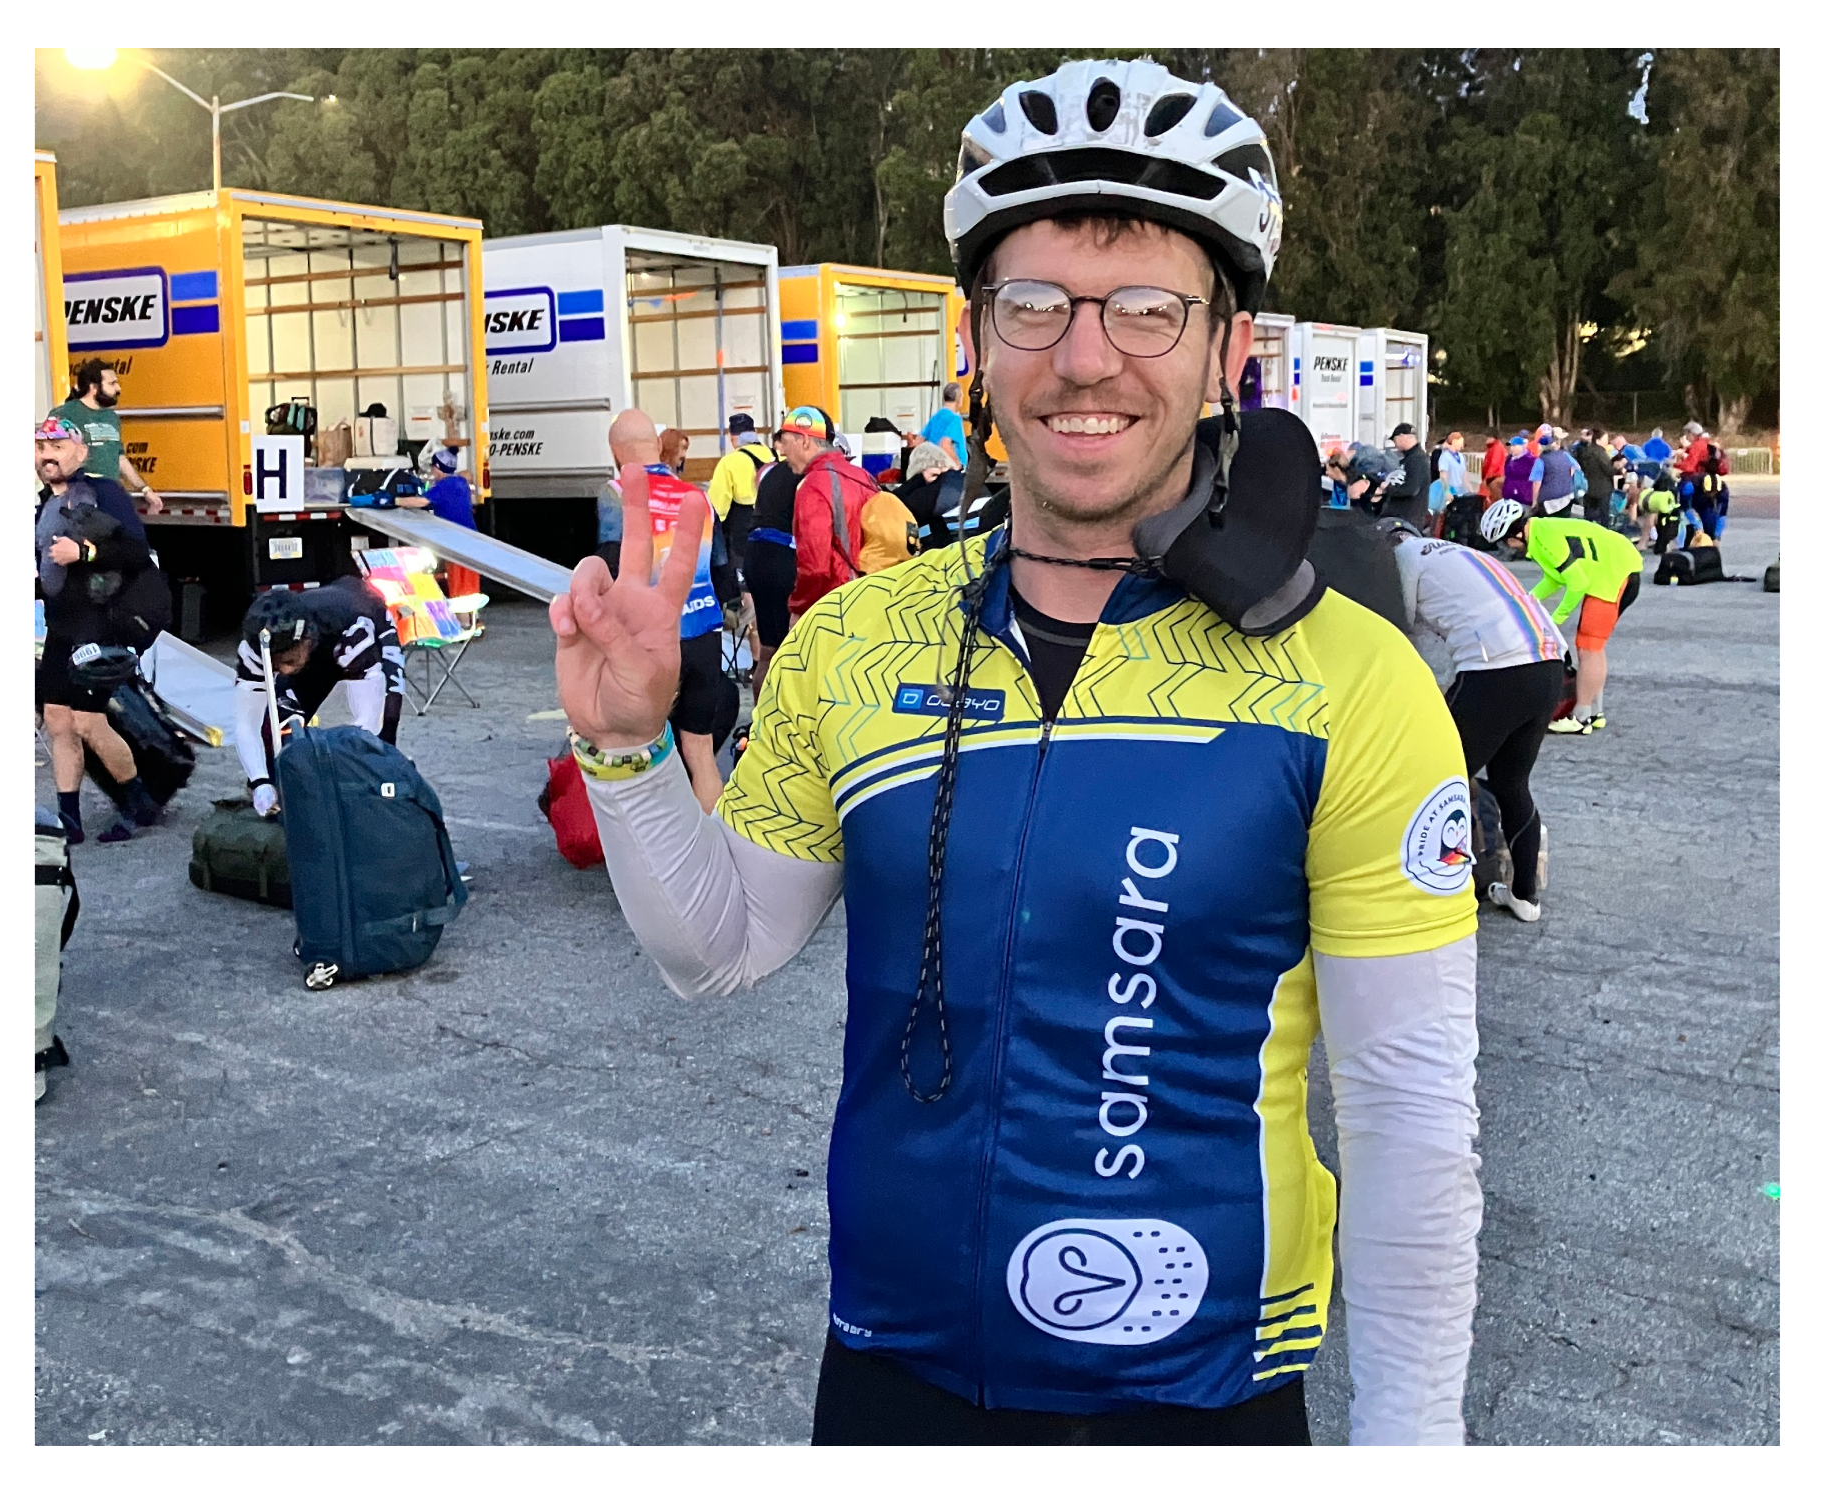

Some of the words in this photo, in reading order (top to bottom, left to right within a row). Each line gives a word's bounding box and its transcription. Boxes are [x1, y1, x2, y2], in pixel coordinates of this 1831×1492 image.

[492, 357, 534, 375] Rental
[1313, 356, 1348, 371] PENSKE
[256, 449, 287, 499] H
[1429, 809, 1438, 823] AT
[1095, 826, 1179, 1178] samsara
